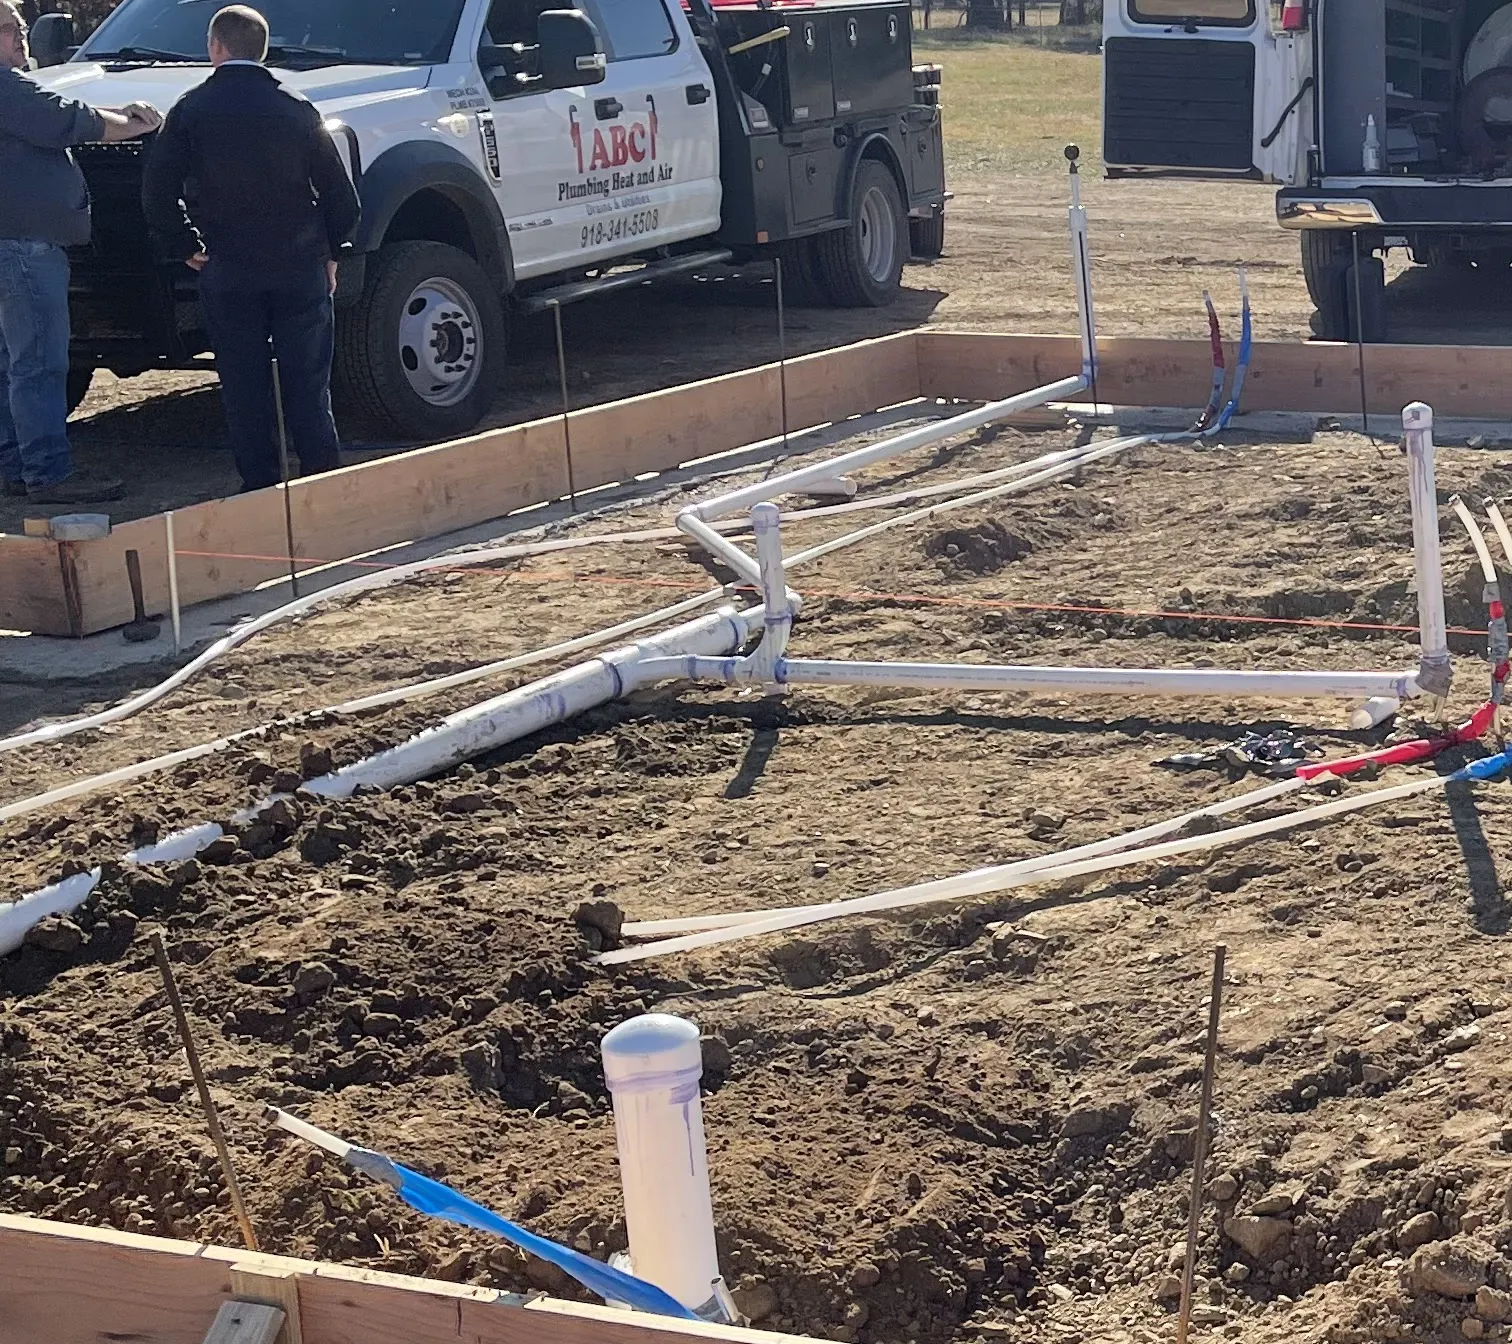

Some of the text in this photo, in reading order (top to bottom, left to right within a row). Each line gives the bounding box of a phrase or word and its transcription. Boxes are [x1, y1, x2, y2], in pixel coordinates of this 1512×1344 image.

[589, 122, 646, 171] ABC
[558, 162, 673, 201] Plumbing Heat and Air
[581, 208, 659, 248] 918-341-5508
